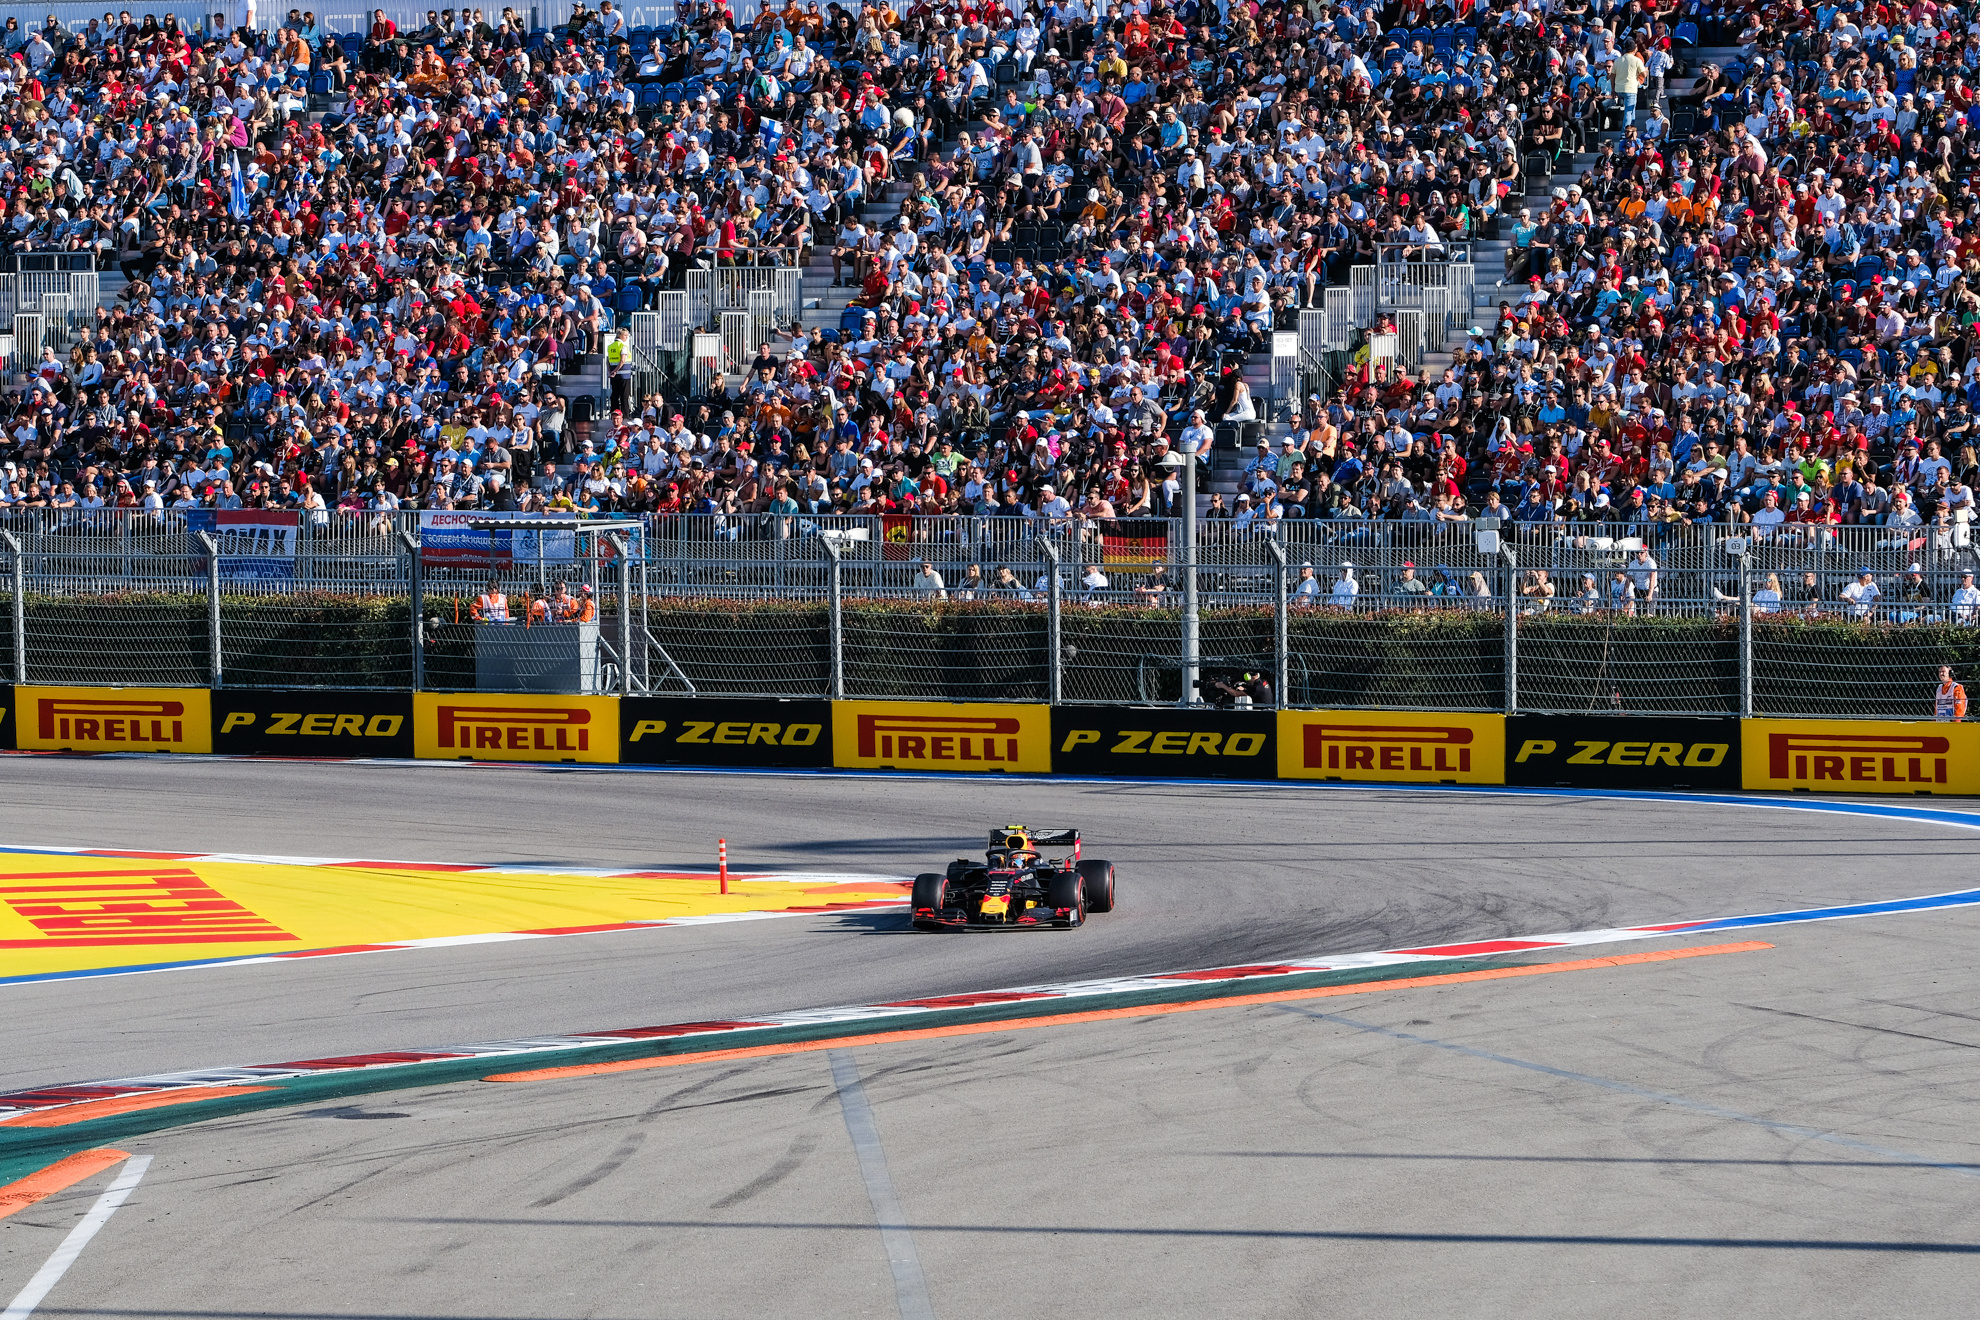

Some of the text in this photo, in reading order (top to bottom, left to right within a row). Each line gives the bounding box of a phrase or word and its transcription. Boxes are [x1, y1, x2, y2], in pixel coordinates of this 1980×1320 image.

[1731, 542, 1741, 550] 03
[38, 698, 184, 743] PIRELLI
[220, 712, 404, 736] P ZERO
[437, 705, 591, 751] PIRELLI
[629, 720, 822, 745] P ZERO
[857, 714, 1020, 762] PIRELLI
[1061, 730, 1266, 756] P ZERO
[1303, 724, 1474, 772] PIRELLI
[1515, 739, 1729, 767] P ZERO
[1769, 733, 1949, 783] PIRELLI
